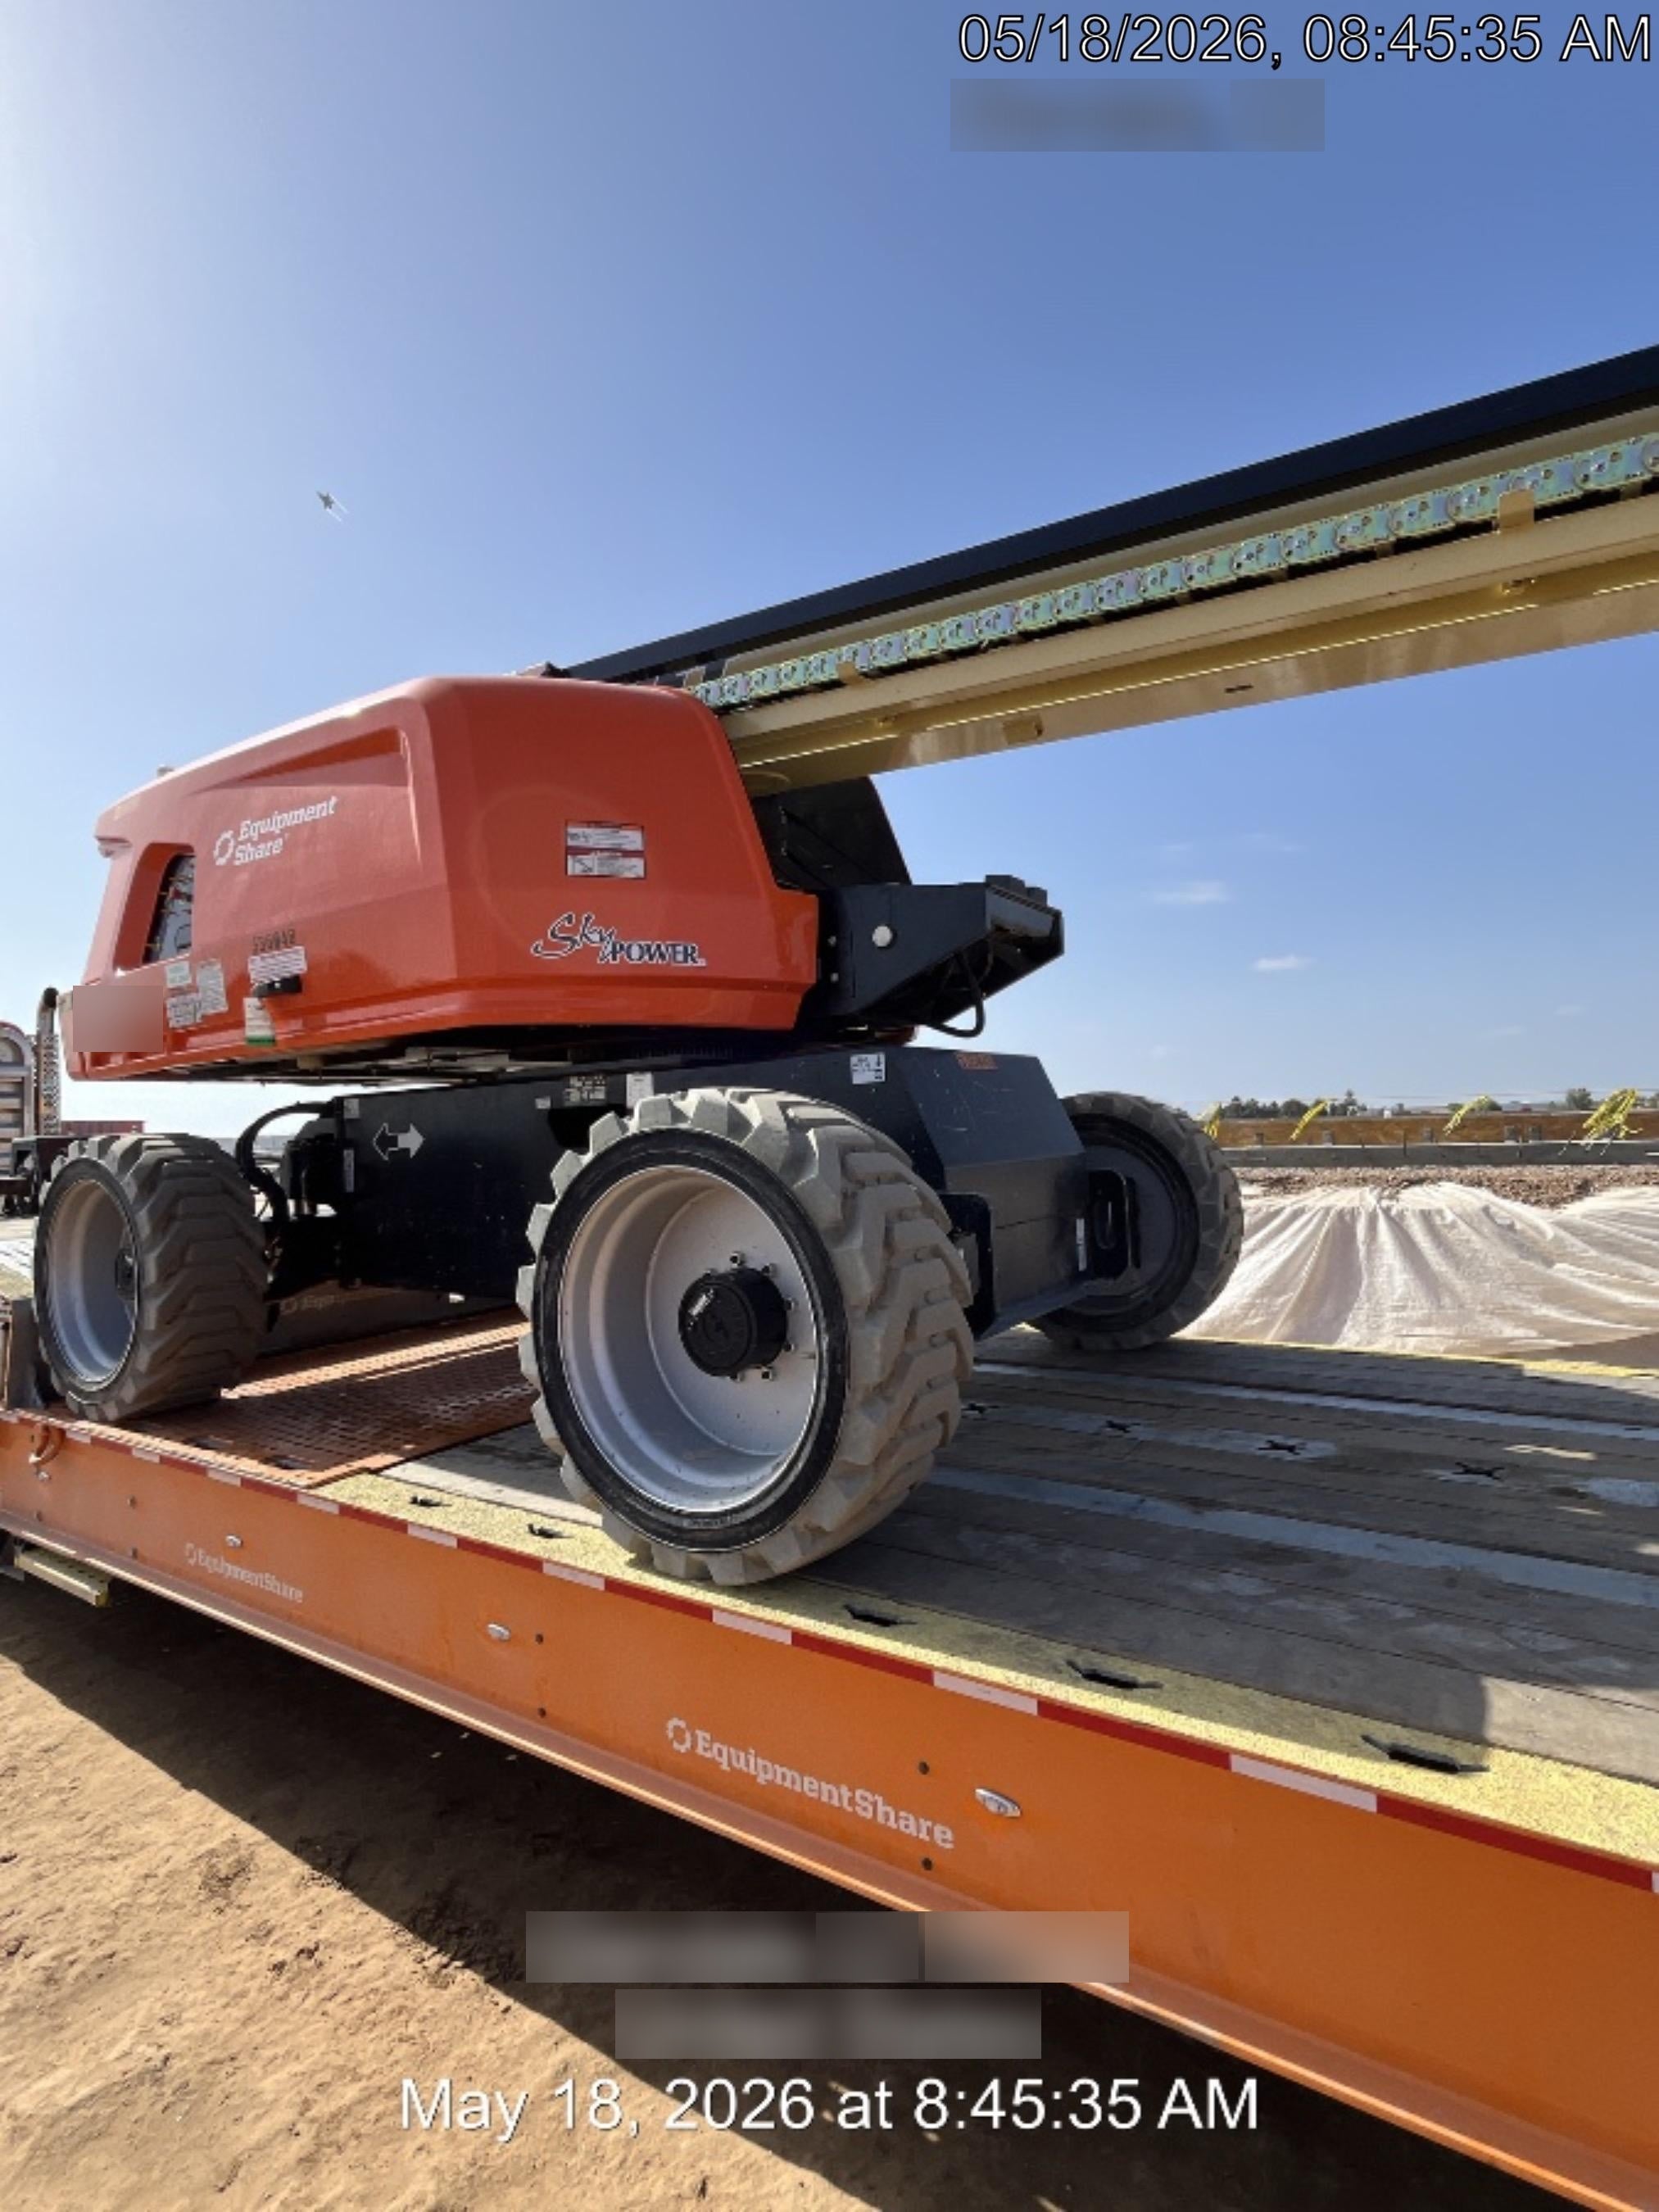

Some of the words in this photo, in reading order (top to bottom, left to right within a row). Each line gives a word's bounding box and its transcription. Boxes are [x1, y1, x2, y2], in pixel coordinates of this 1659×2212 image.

[238, 796, 338, 841] Equipment
[233, 837, 284, 866] Share
[531, 912, 618, 964] Sky
[610, 941, 699, 964] POWER
[198, 1547, 303, 1603] EquipmentShare
[695, 1729, 955, 1850] EquipmentShare
